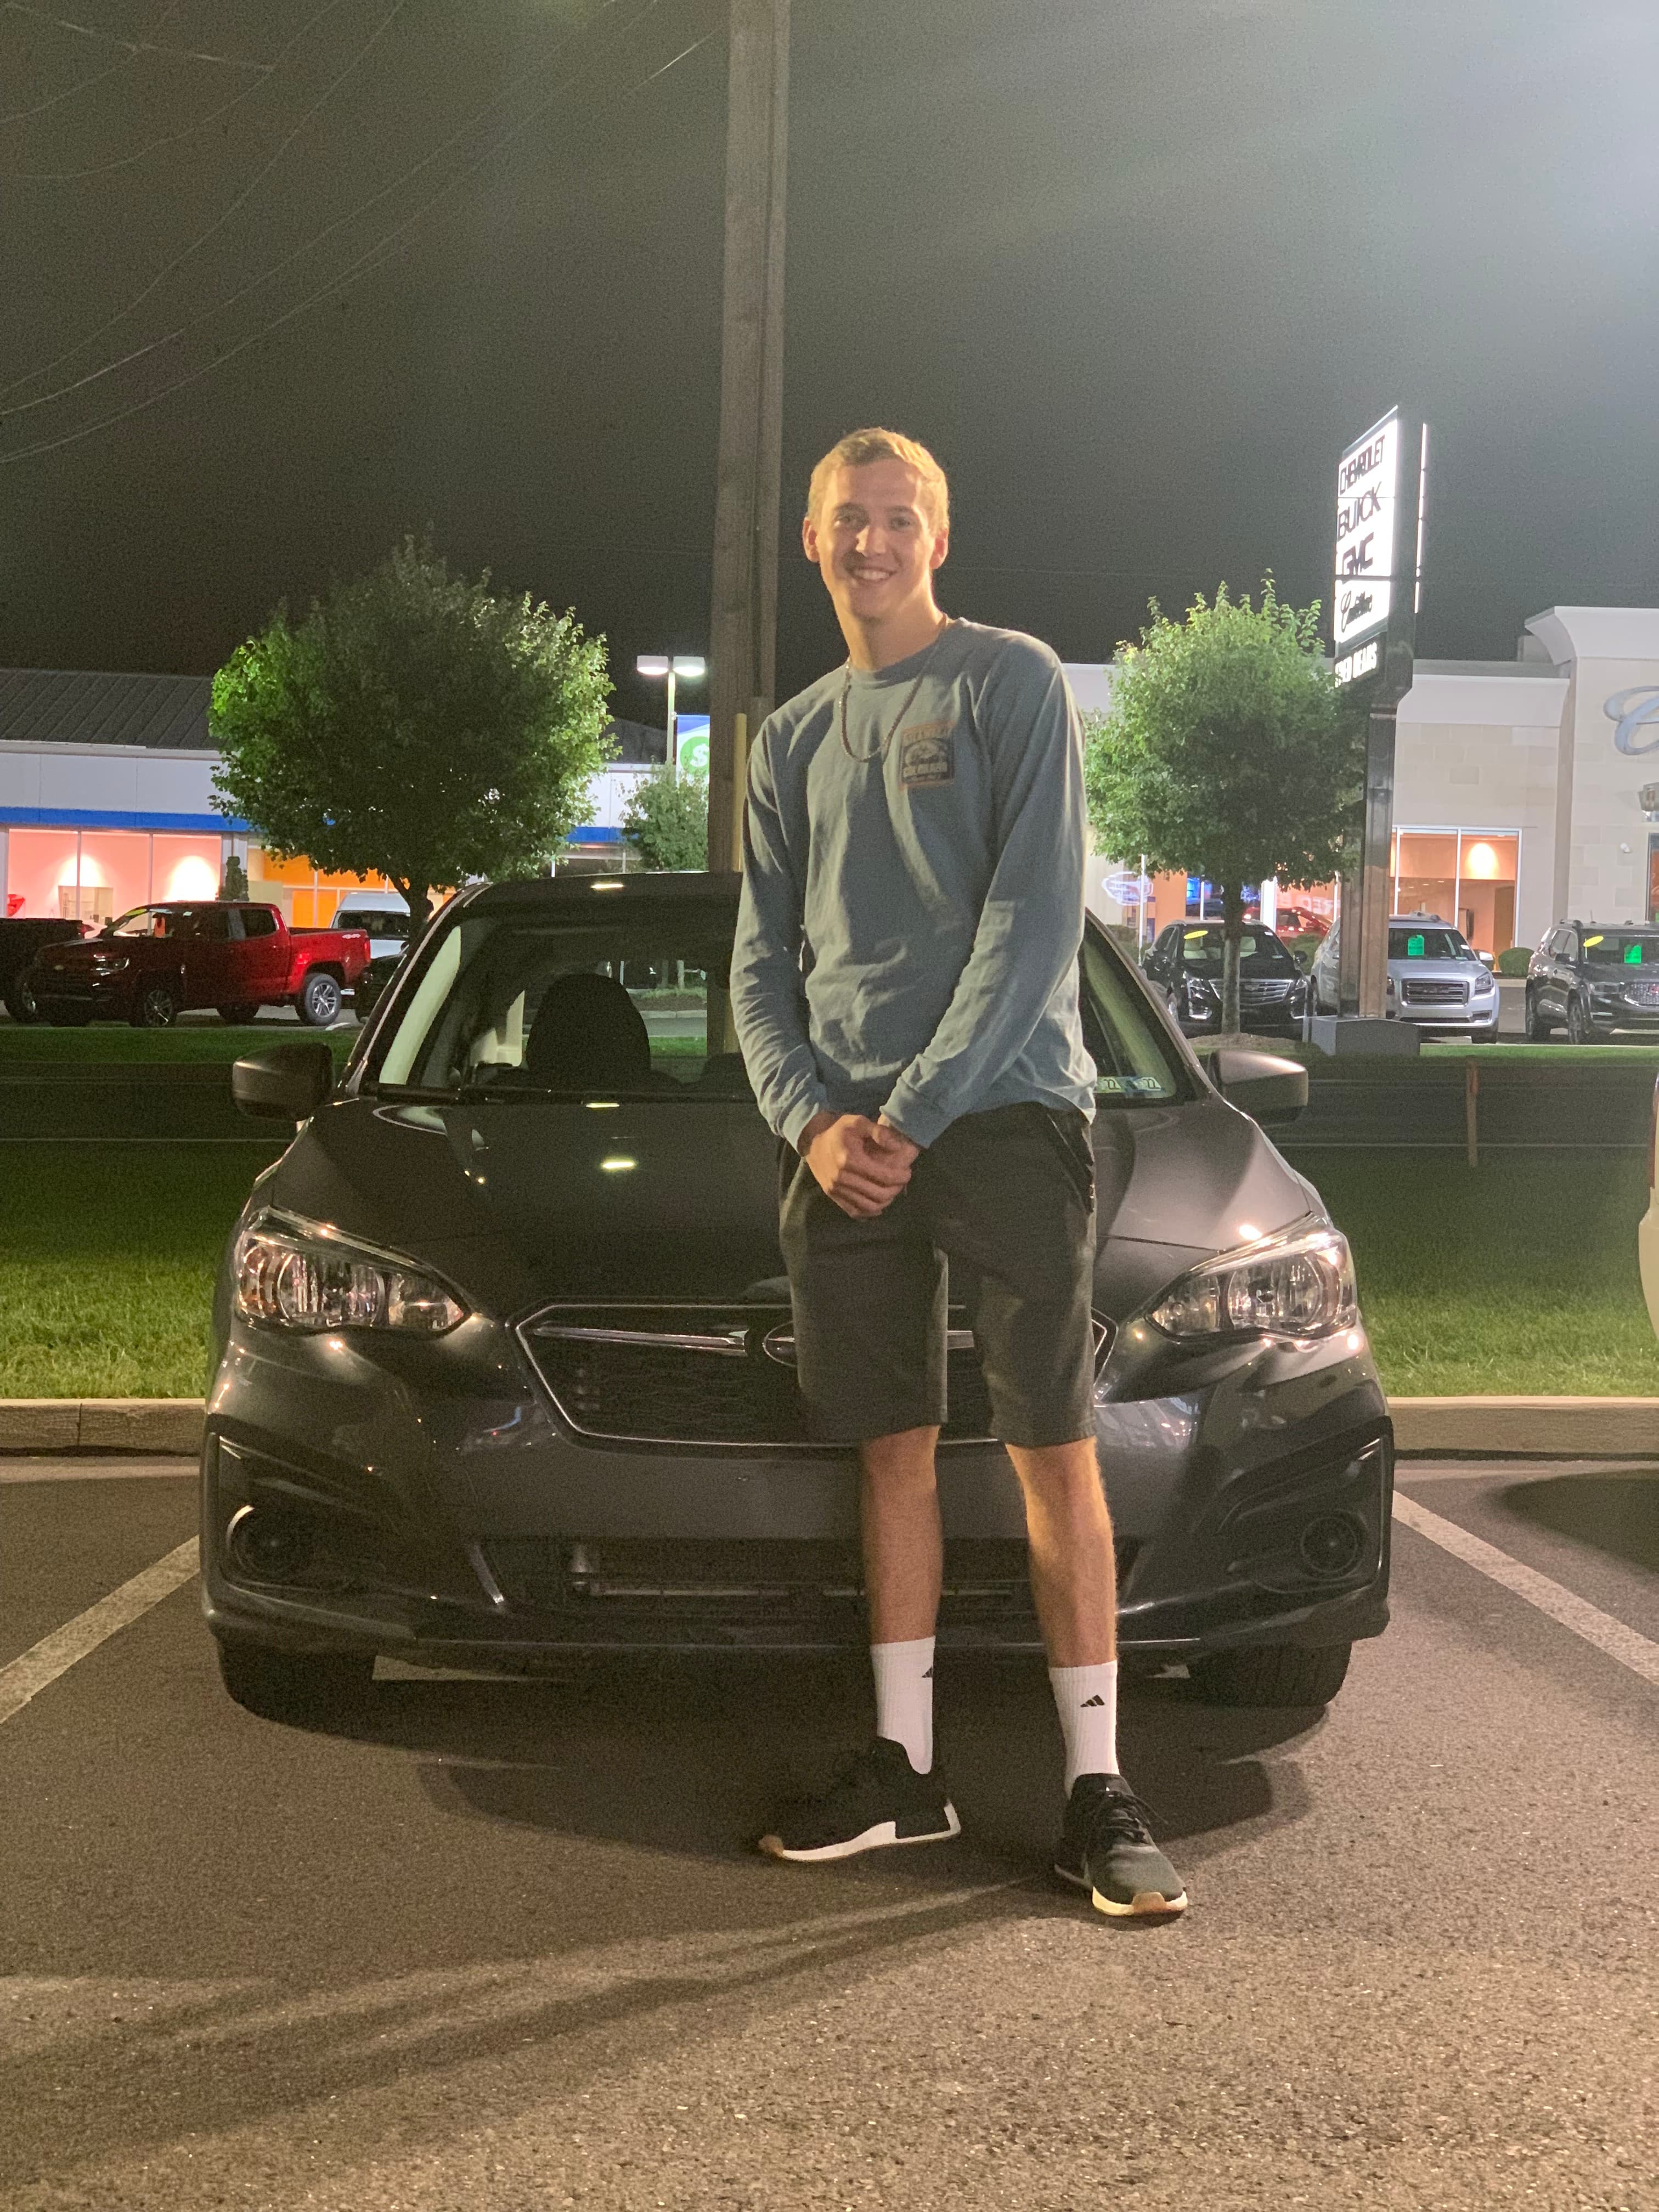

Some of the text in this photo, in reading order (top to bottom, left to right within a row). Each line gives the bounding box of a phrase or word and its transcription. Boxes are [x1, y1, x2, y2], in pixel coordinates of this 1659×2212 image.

[1340, 435, 1385, 495] CHEVROLET
[1337, 481, 1382, 542] BUICK
[1342, 531, 1374, 575] GMC
